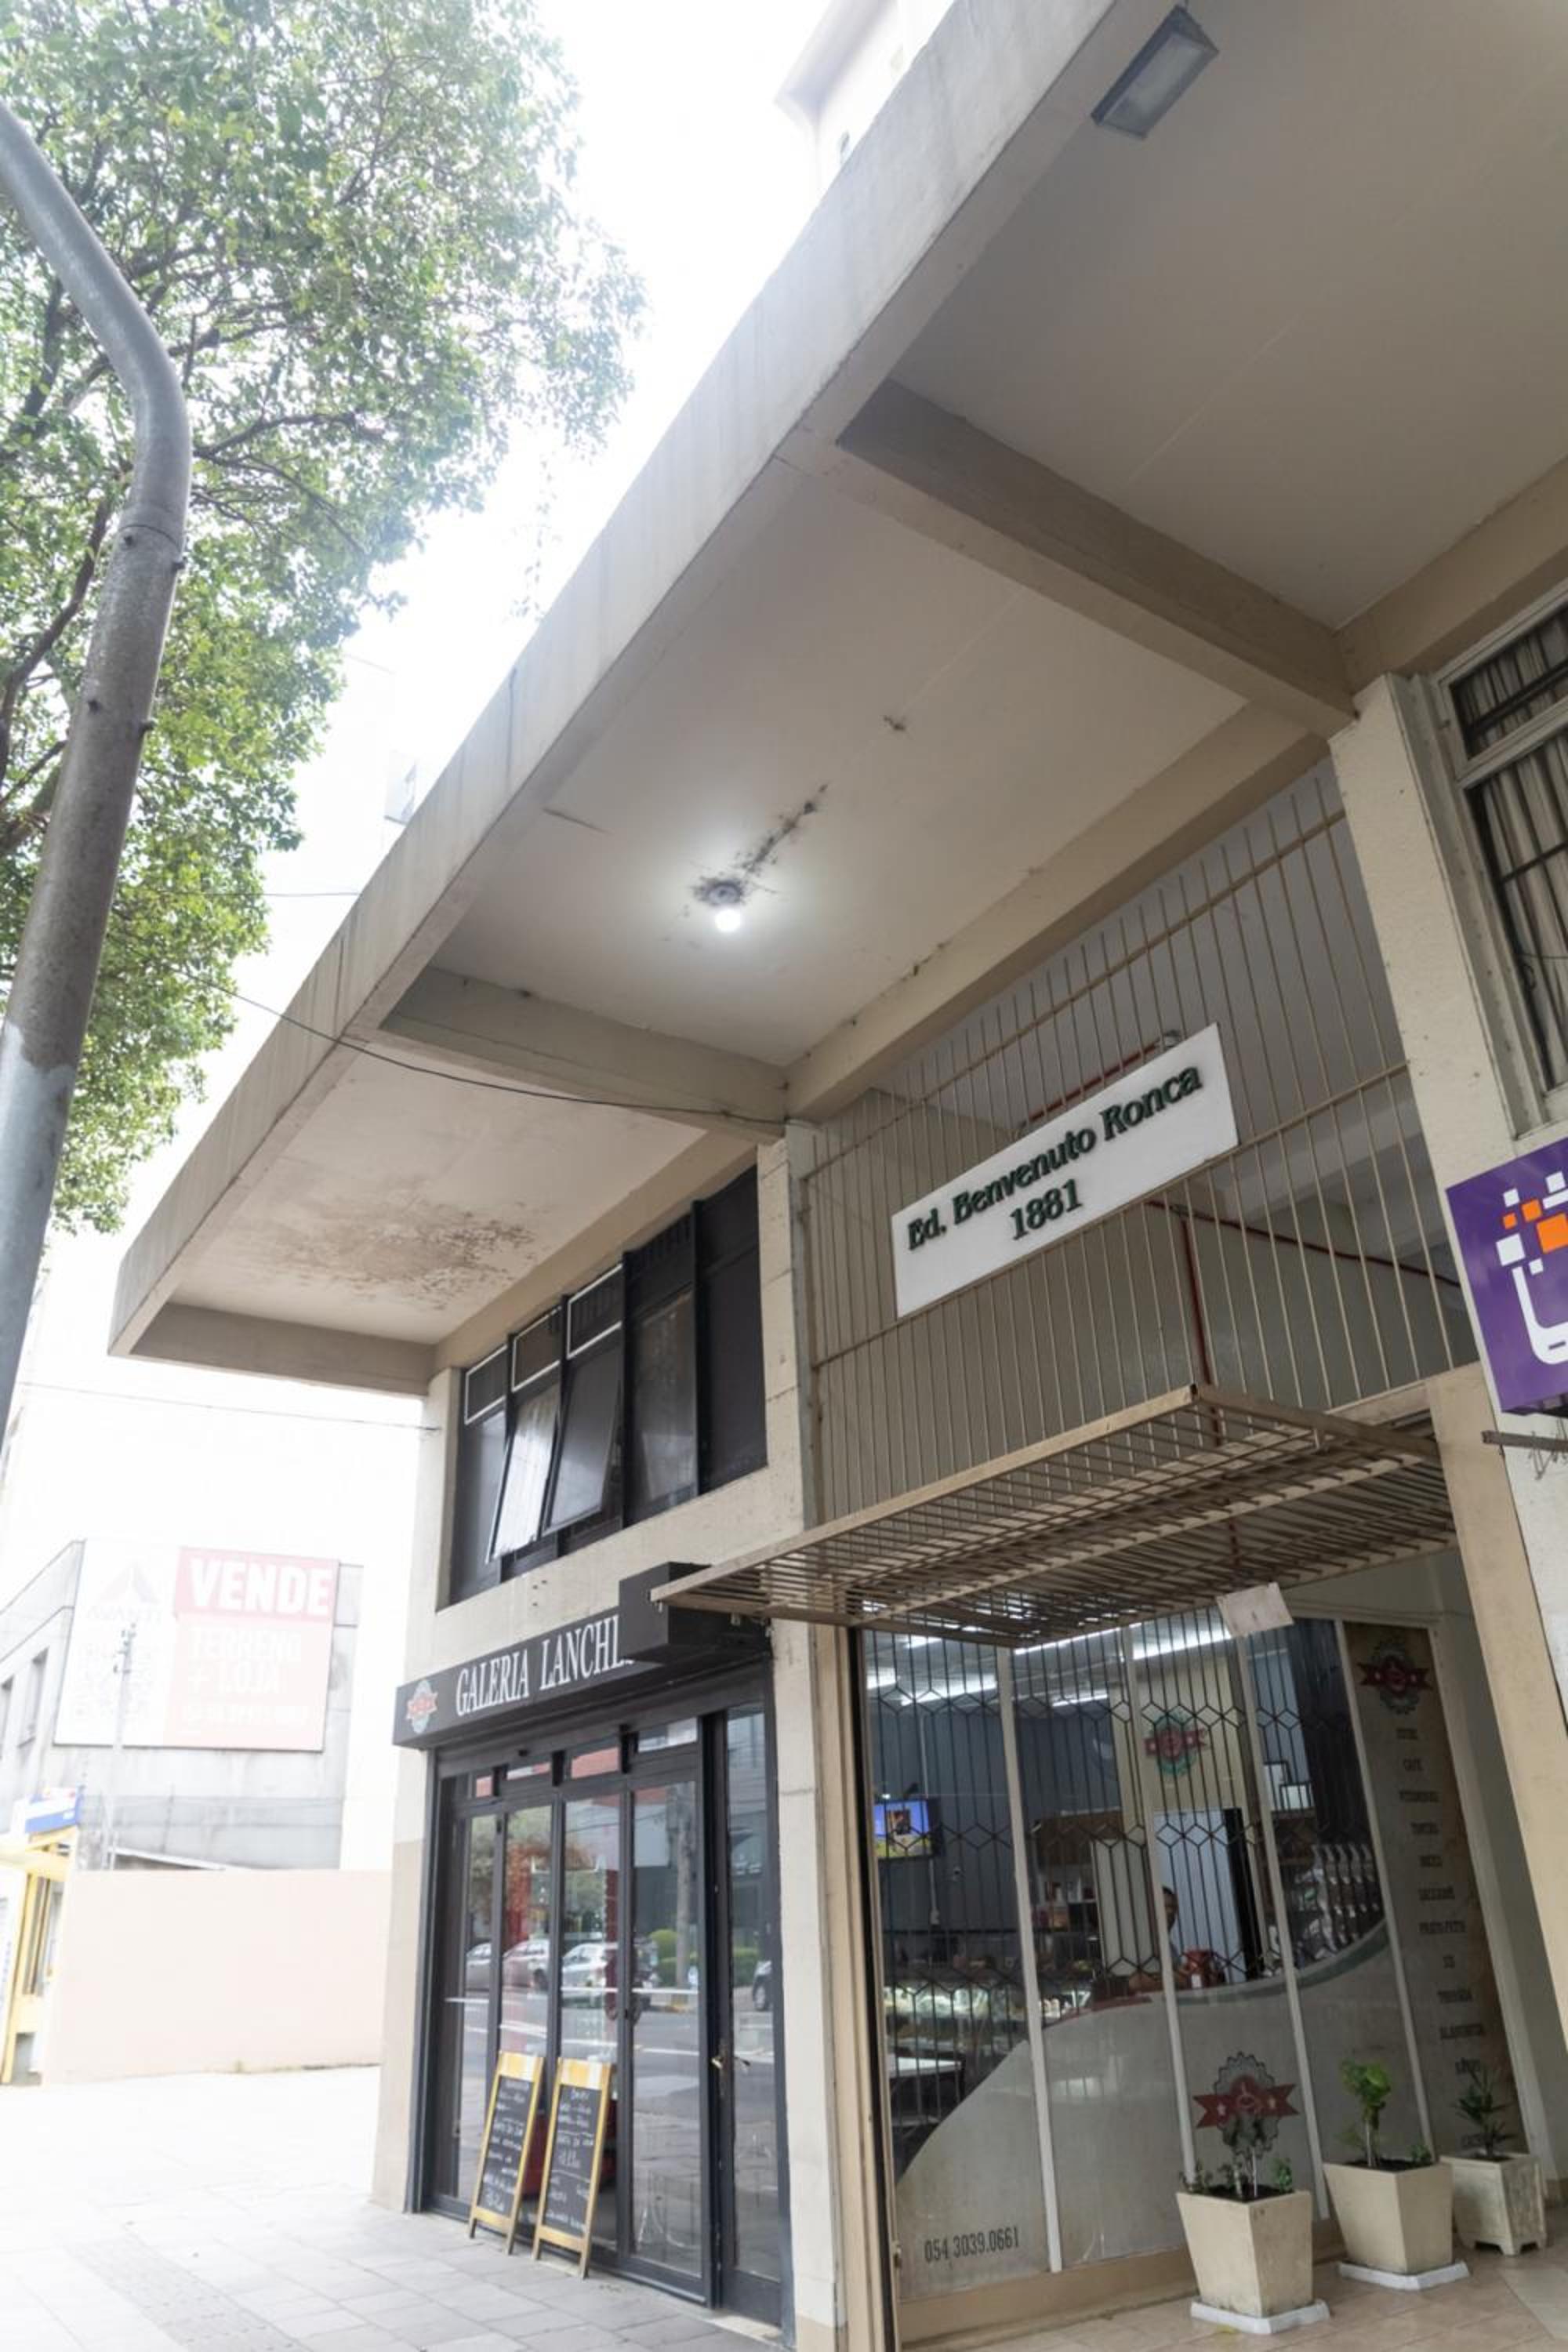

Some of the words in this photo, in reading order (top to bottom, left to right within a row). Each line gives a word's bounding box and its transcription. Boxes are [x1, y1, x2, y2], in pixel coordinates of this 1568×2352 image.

[907, 1208, 947, 1250] Ed.
[953, 1127, 1096, 1228] Benvenuto
[1099, 1066, 1203, 1142] Ronca
[1009, 1179, 1083, 1240] 1881
[188, 1557, 331, 1615] VENDE
[456, 1650, 529, 1715] GALERIA
[539, 1615, 633, 1690] LANCHE
[925, 2237, 949, 2263] 054
[953, 2226, 1019, 2258] 3039.0661
